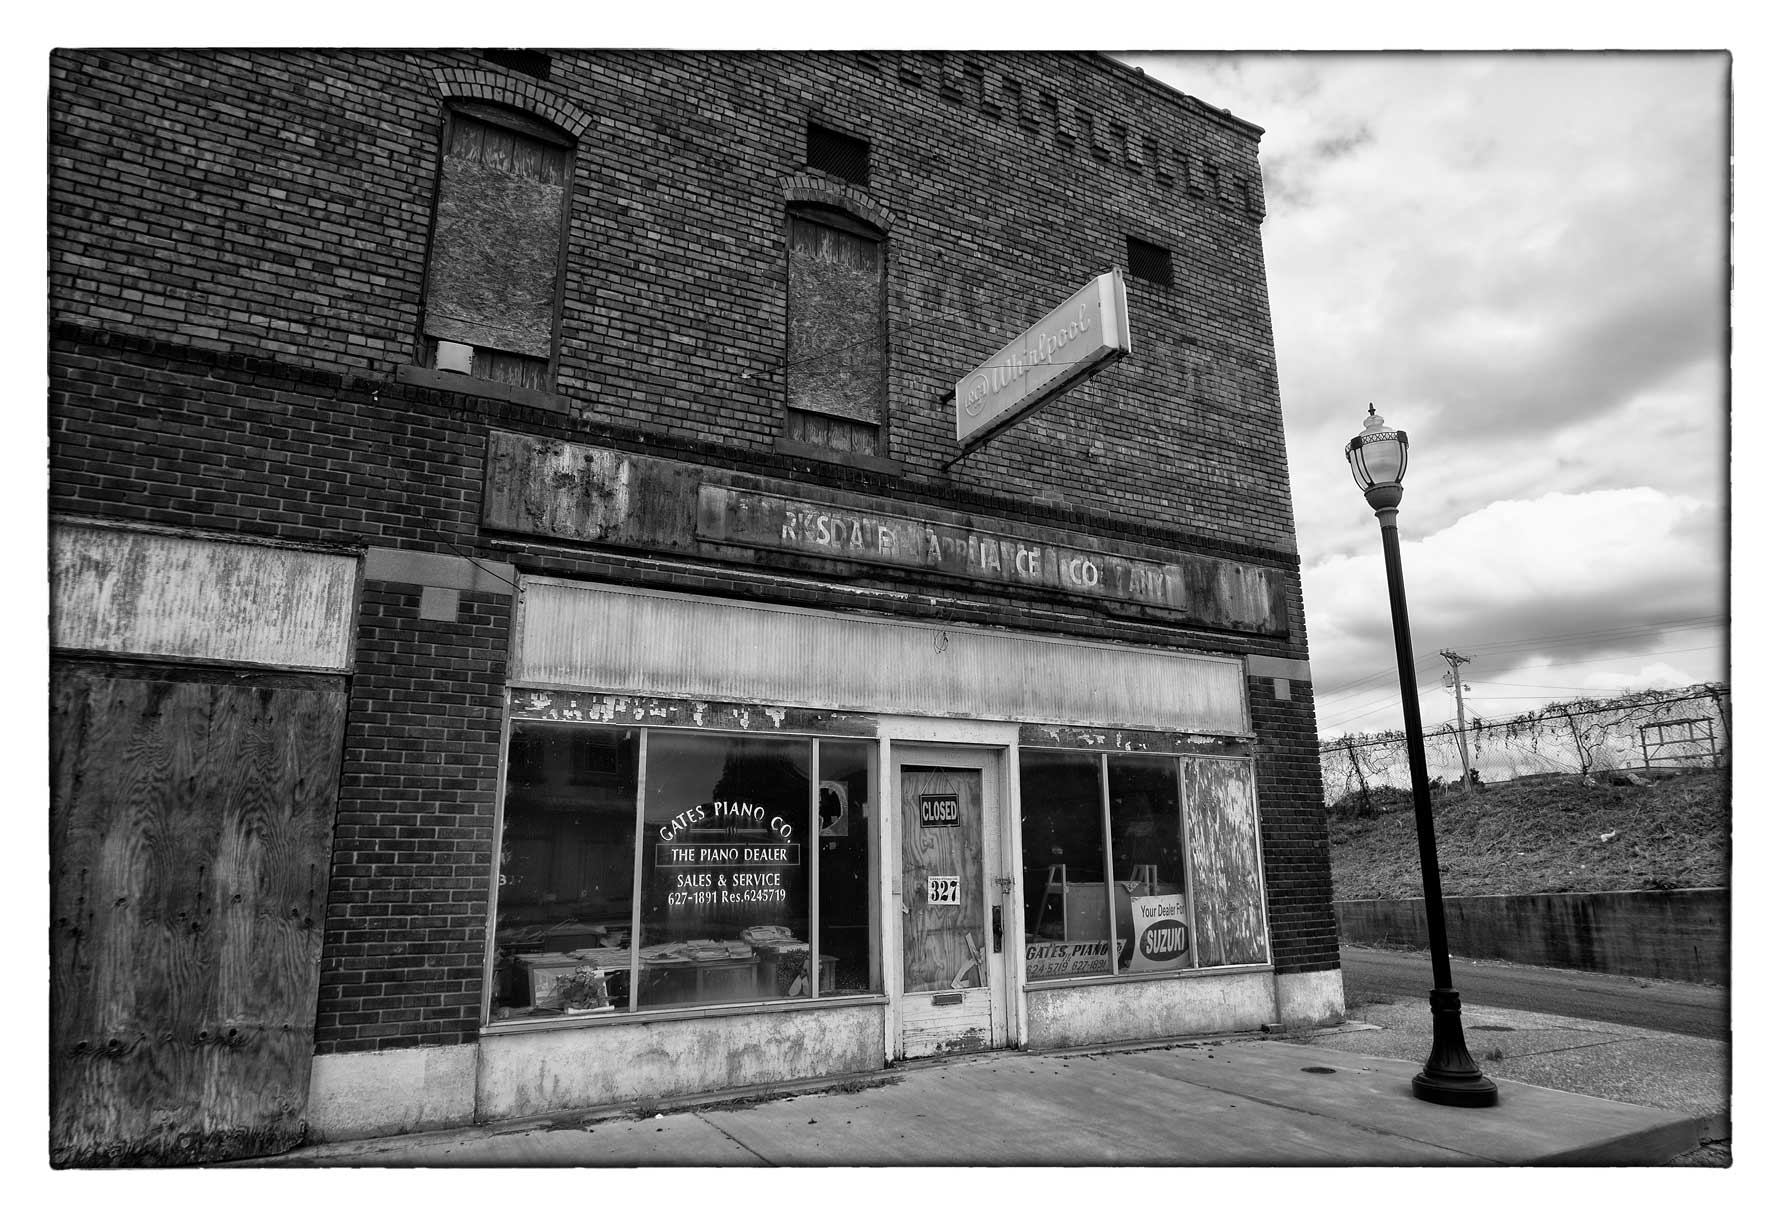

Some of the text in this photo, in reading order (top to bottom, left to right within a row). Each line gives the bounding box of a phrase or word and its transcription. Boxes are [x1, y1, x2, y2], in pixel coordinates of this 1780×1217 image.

[991, 303, 1091, 393] Whirlpool
[922, 801, 957, 821] CLOSED
[659, 801, 792, 843] GATES PIANO CO.
[671, 848, 787, 861] THE PIANO DEALER
[677, 873, 781, 887] SALES & SERVICE
[668, 892, 717, 905] 627-1891
[931, 880, 957, 902] 327
[1140, 903, 1185, 918] Your Dealer For
[1146, 927, 1185, 954] SUZUKI
[1026, 945, 1068, 960] GATES
[1072, 943, 1108, 956] PIANO
